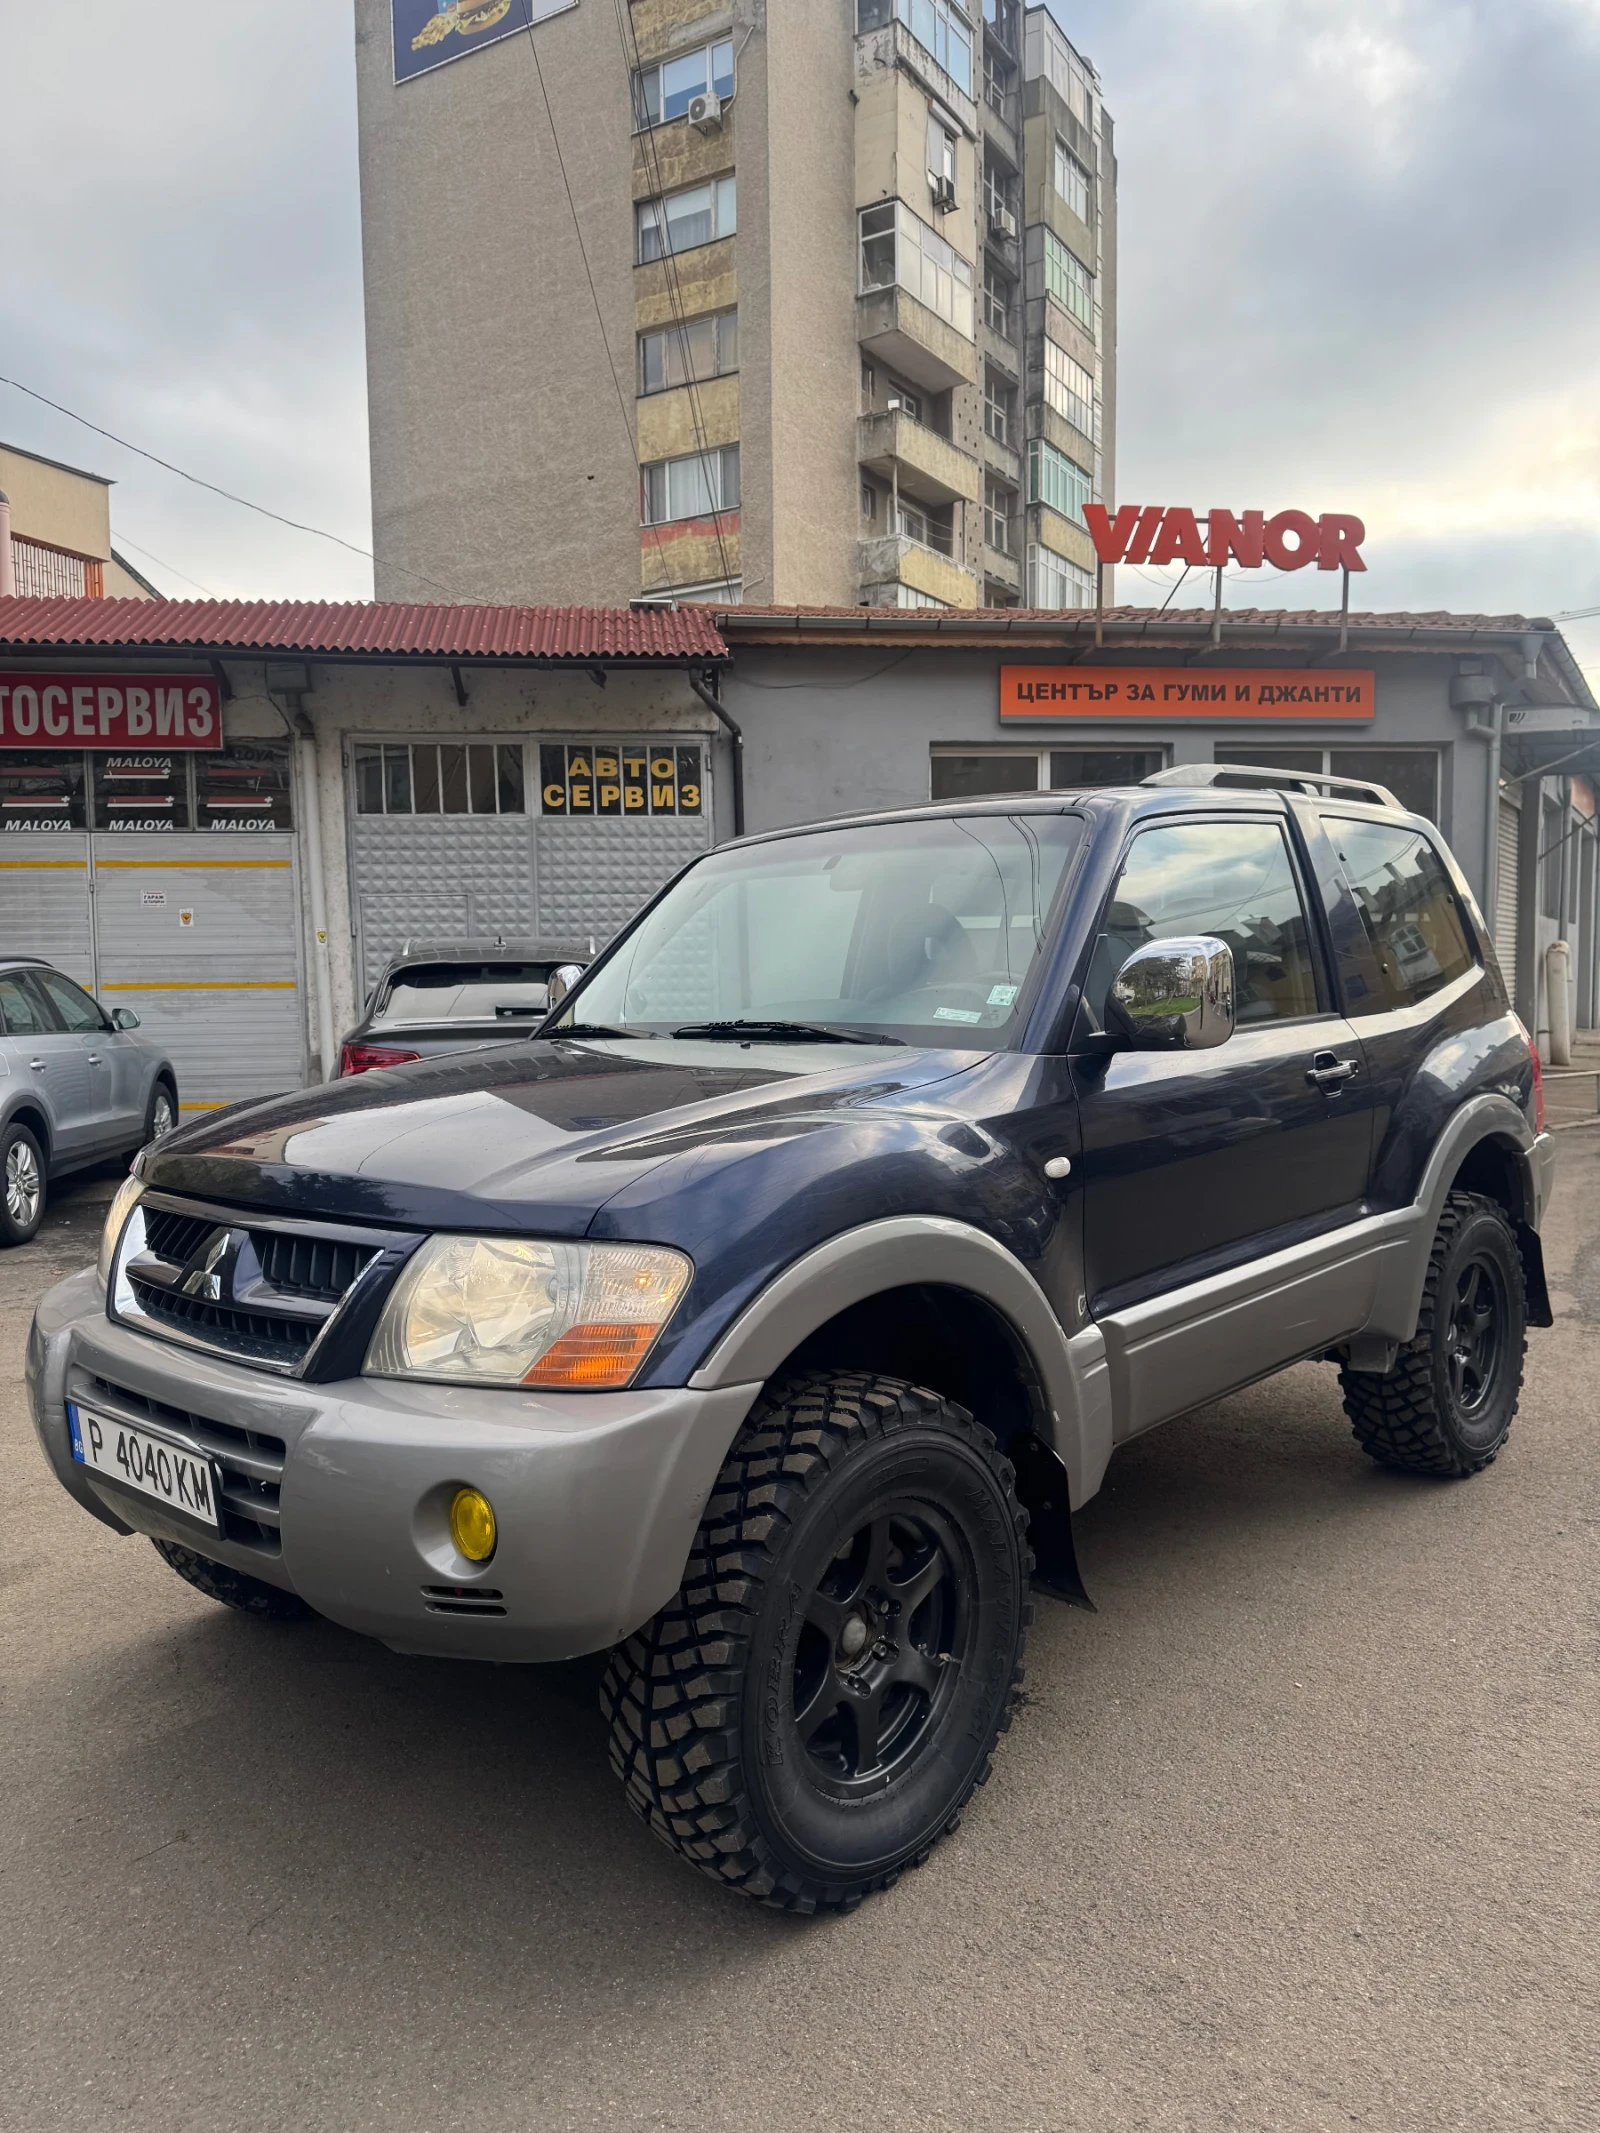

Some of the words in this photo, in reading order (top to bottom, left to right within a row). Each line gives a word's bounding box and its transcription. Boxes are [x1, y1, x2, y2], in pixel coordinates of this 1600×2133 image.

[1082, 503, 1368, 572] VIANOR
[1017, 682, 1119, 703] ЦЕНТЪР
[1126, 683, 1156, 701] ЗА
[1163, 684, 1227, 702] ГУМИ
[1235, 685, 1251, 702] И
[1258, 685, 1362, 706] ДЖАНТИ
[106, 757, 172, 768] MALOYA
[567, 756, 675, 779] АВТО
[543, 784, 700, 809] СЕРВИЗ
[4, 819, 72, 831] MALOYA
[108, 819, 174, 831] MALOYA
[211, 819, 276, 831] MALOYA
[73, 1438, 84, 1455] BG
